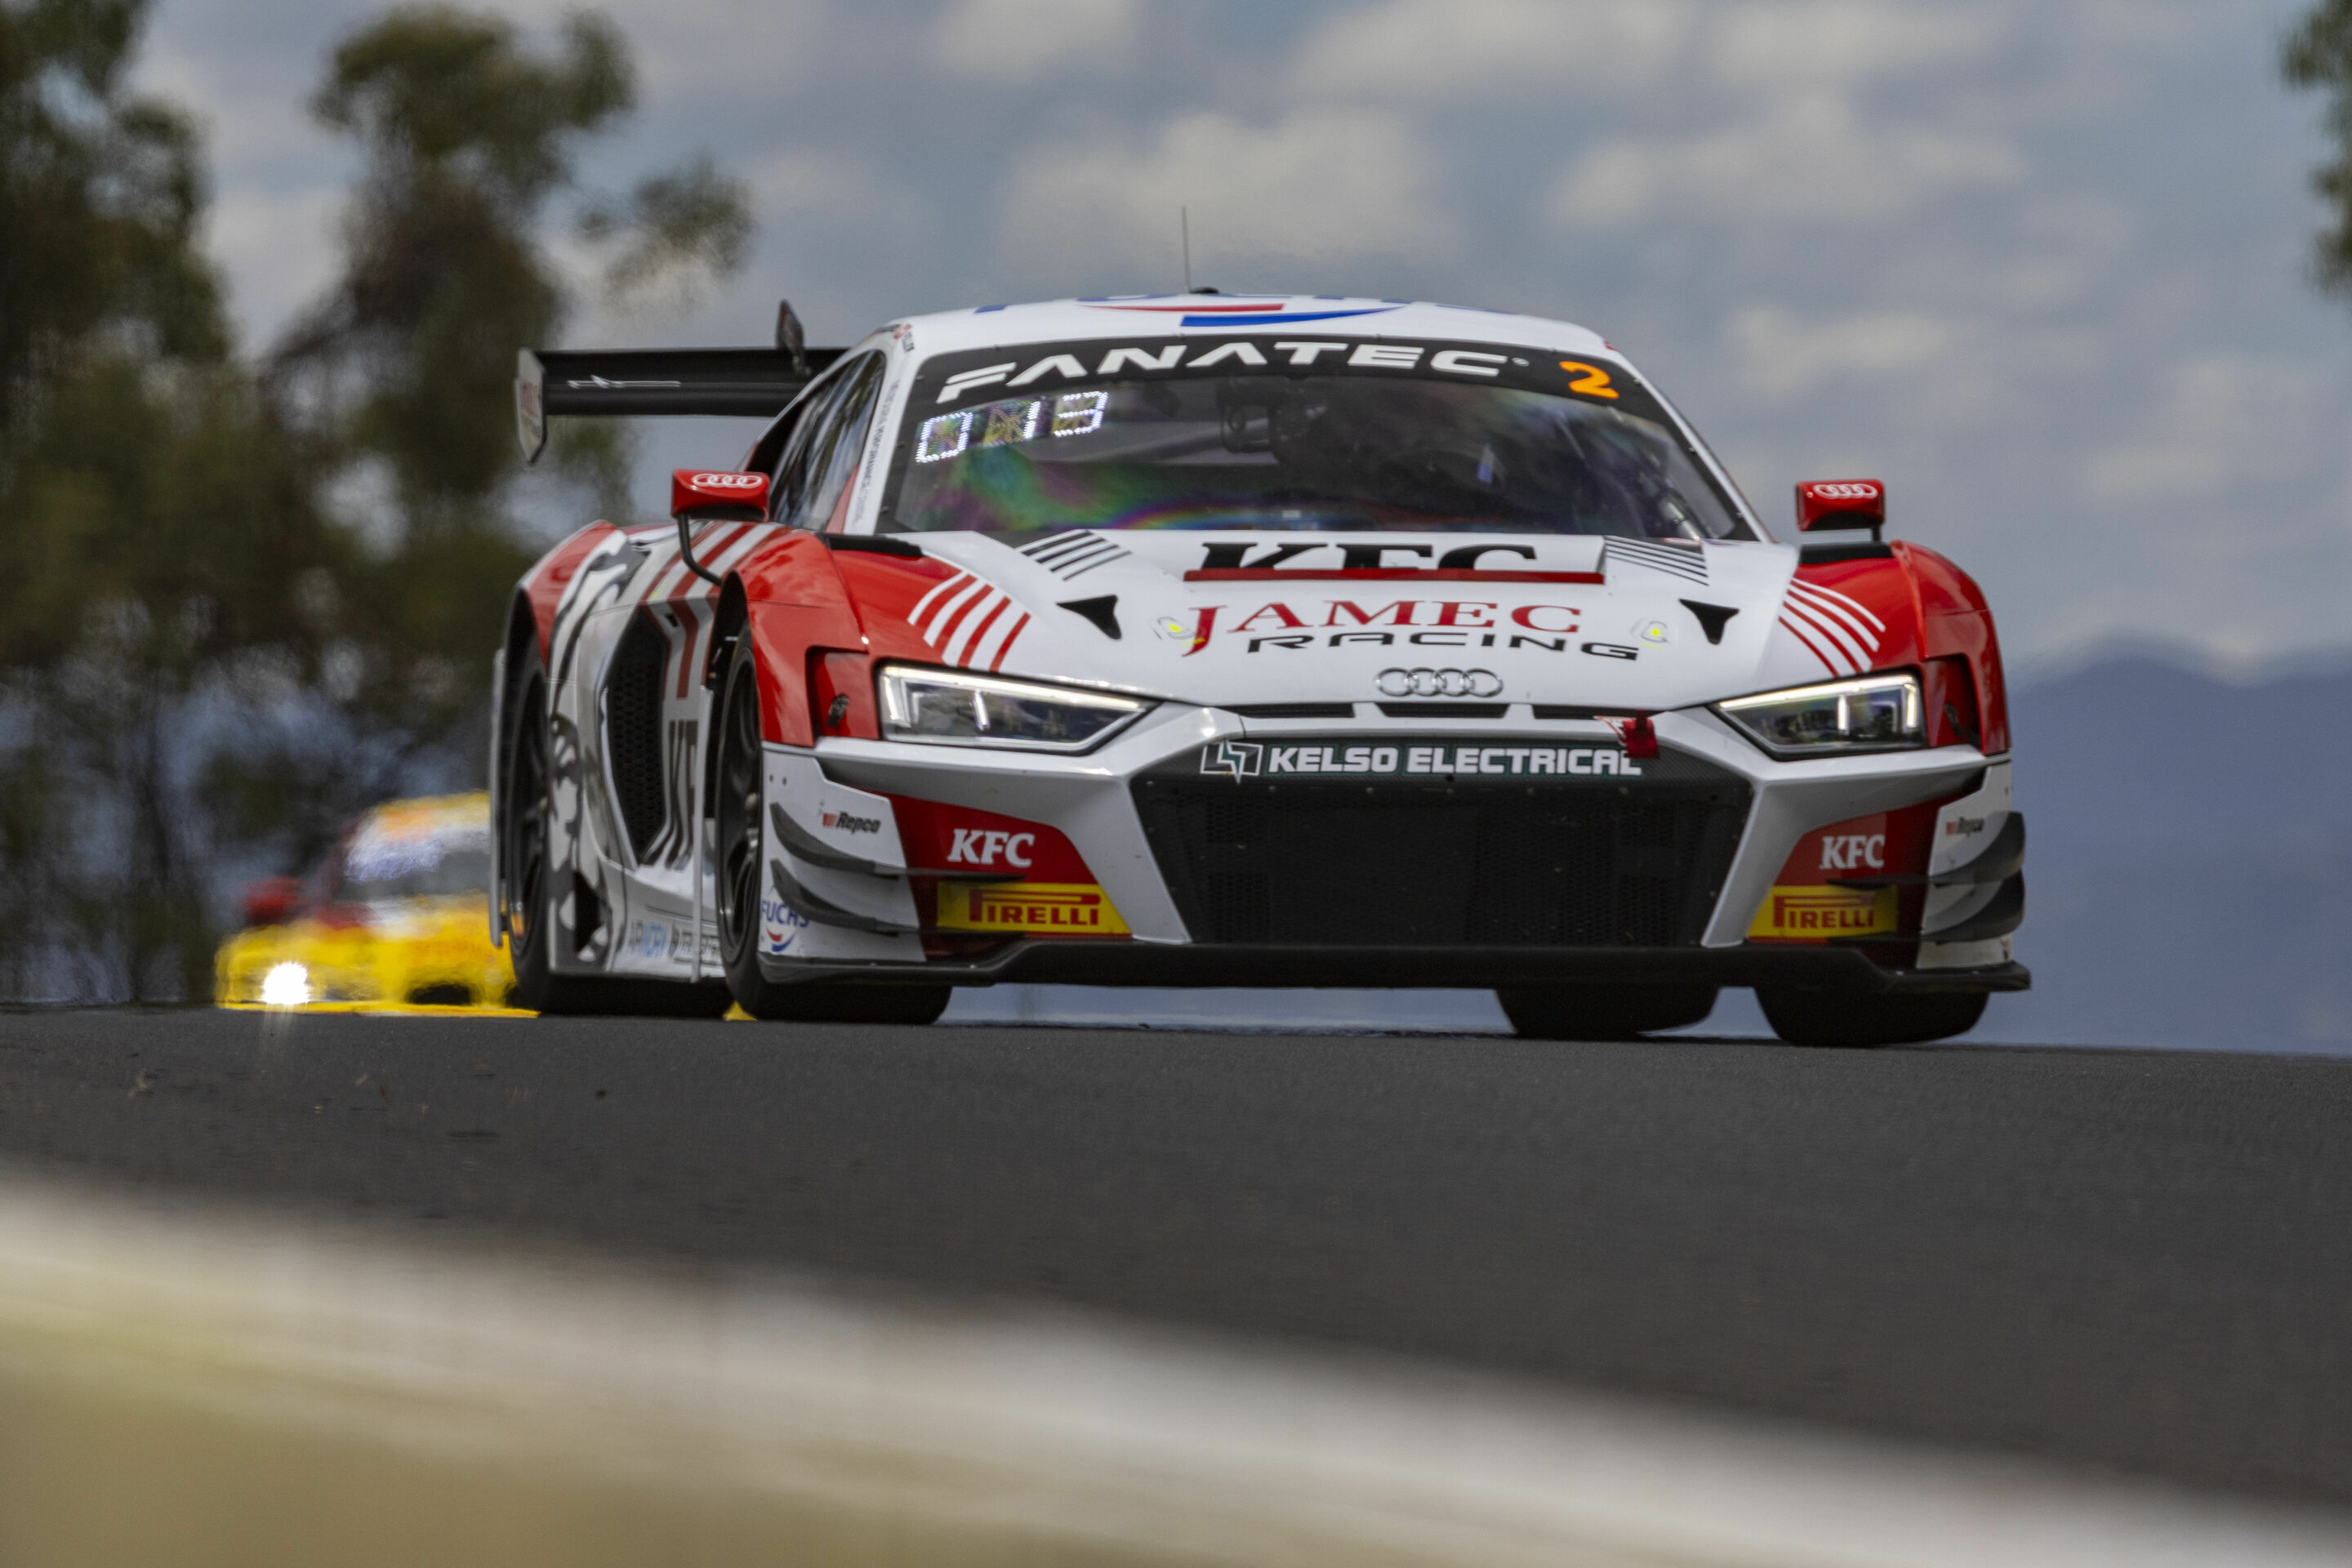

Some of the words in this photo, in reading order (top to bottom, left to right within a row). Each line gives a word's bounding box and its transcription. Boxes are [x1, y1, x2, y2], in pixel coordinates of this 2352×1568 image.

[937, 342, 1508, 403] FANATEC
[1560, 361, 1619, 399] 2
[1181, 599, 1581, 657] JAMEC
[1246, 631, 1640, 661] RACING
[1268, 746, 1399, 773] KELSO
[1406, 746, 1642, 776] ELECTRICAL
[836, 810, 881, 834] Repco
[947, 828, 1035, 867] KFC
[1820, 835, 1885, 869] KFC
[969, 889, 1101, 926] PIRELLI
[1772, 893, 1875, 929] PIRELLI
